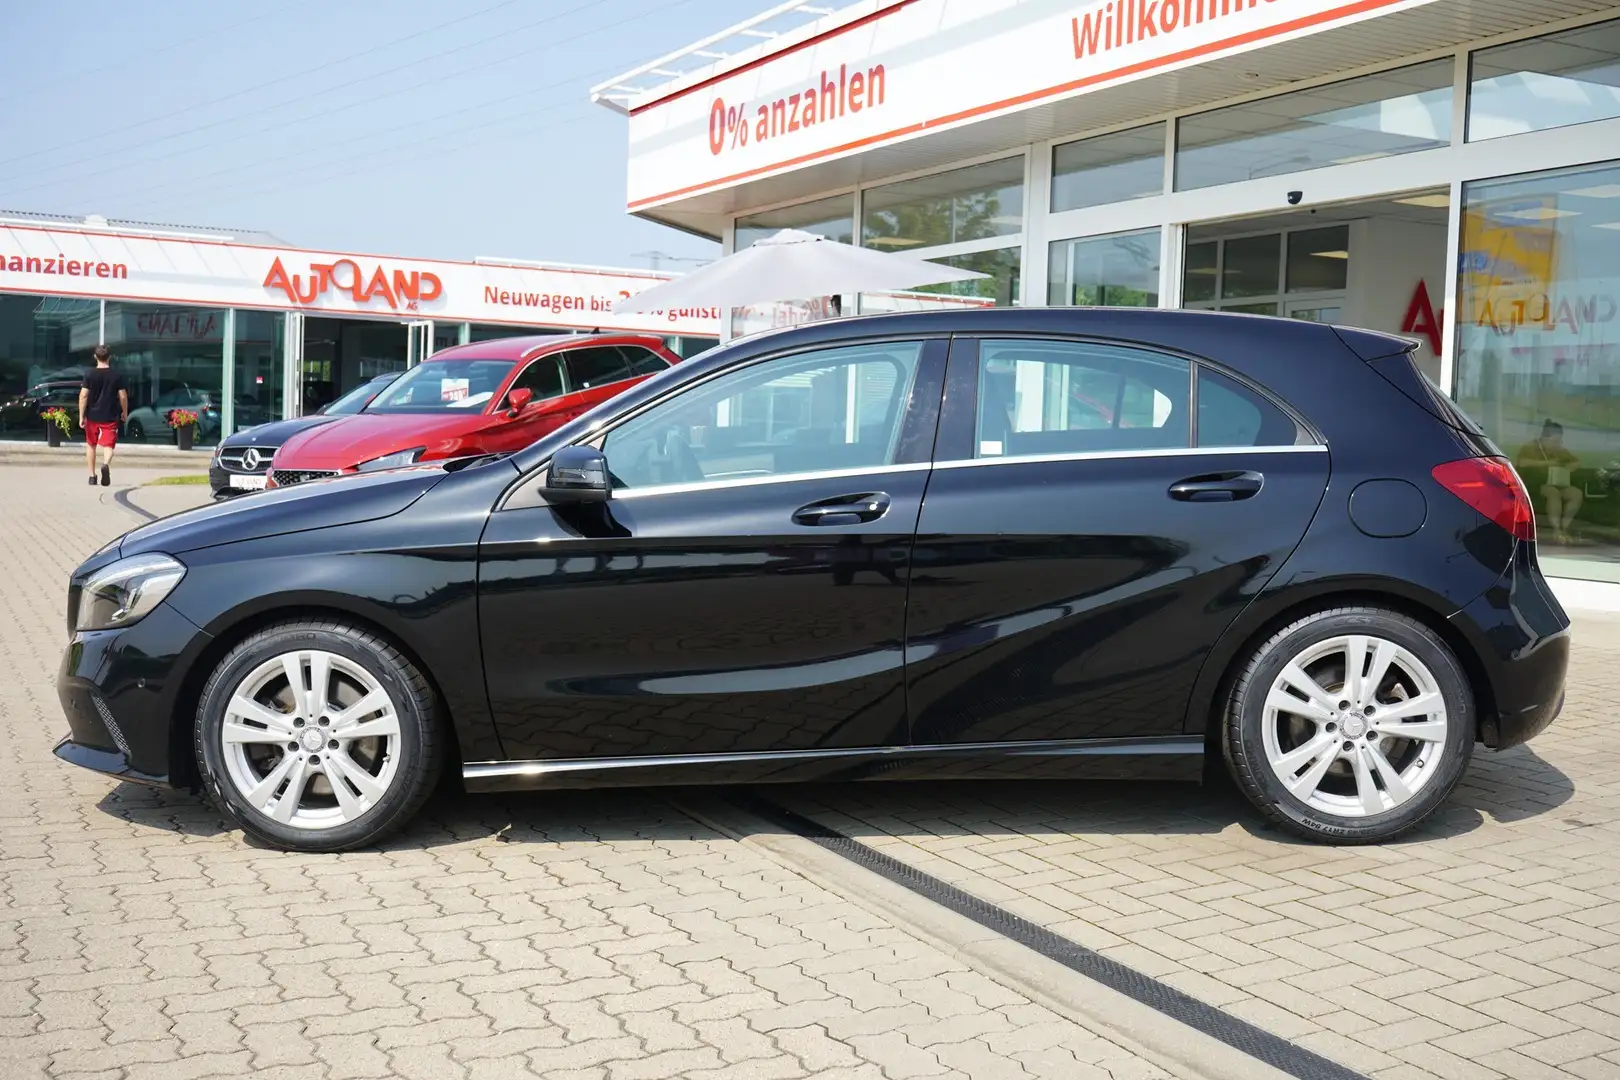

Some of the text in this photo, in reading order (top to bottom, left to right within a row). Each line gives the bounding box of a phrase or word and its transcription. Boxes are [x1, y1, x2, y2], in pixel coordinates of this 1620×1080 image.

[709, 63, 885, 156] 0% anzahlen
[263, 256, 443, 309] AUTOLAND
[484, 285, 585, 314] Neuwagen
[590, 295, 612, 312] bis
